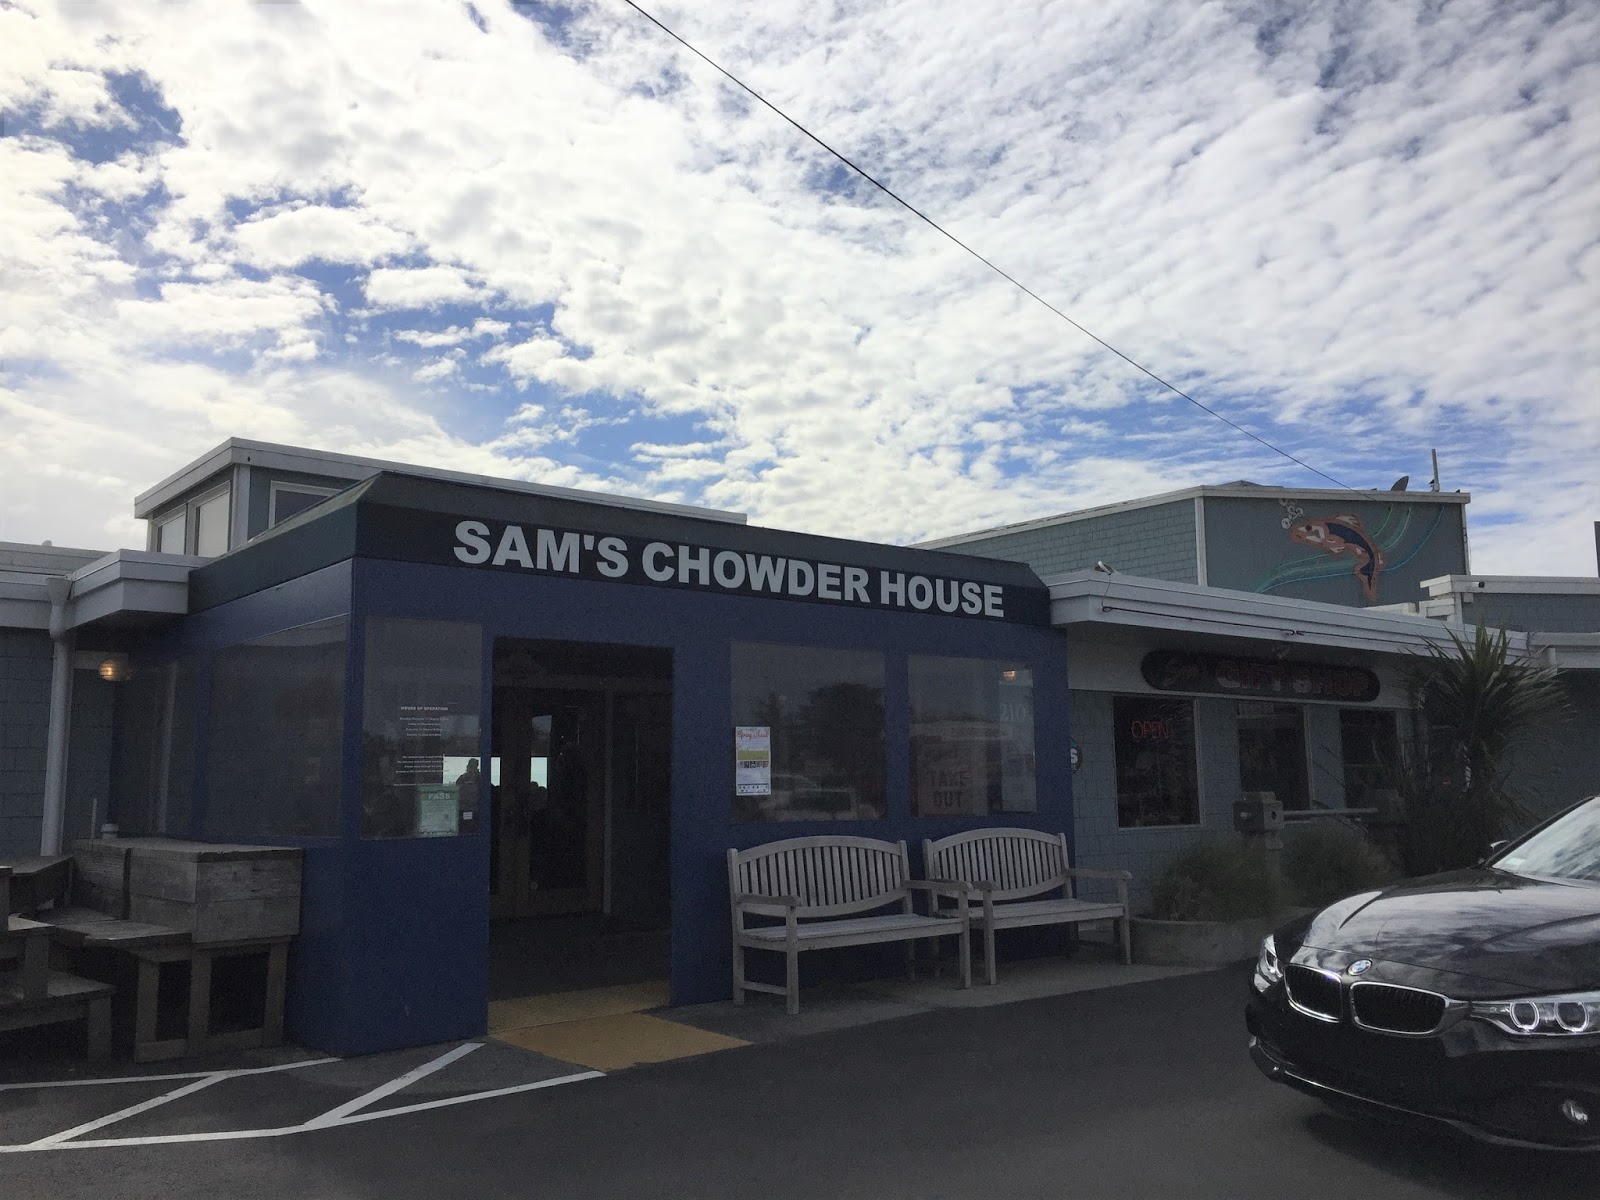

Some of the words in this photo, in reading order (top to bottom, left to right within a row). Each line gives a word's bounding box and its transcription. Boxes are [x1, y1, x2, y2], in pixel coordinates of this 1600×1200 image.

[453, 520, 629, 577] SAM'S
[642, 541, 870, 603] CHOWDER
[880, 570, 1004, 617] HOUSE
[1131, 720, 1169, 740] OPEN
[428, 792, 451, 801] PASS
[933, 790, 963, 808] OUT
